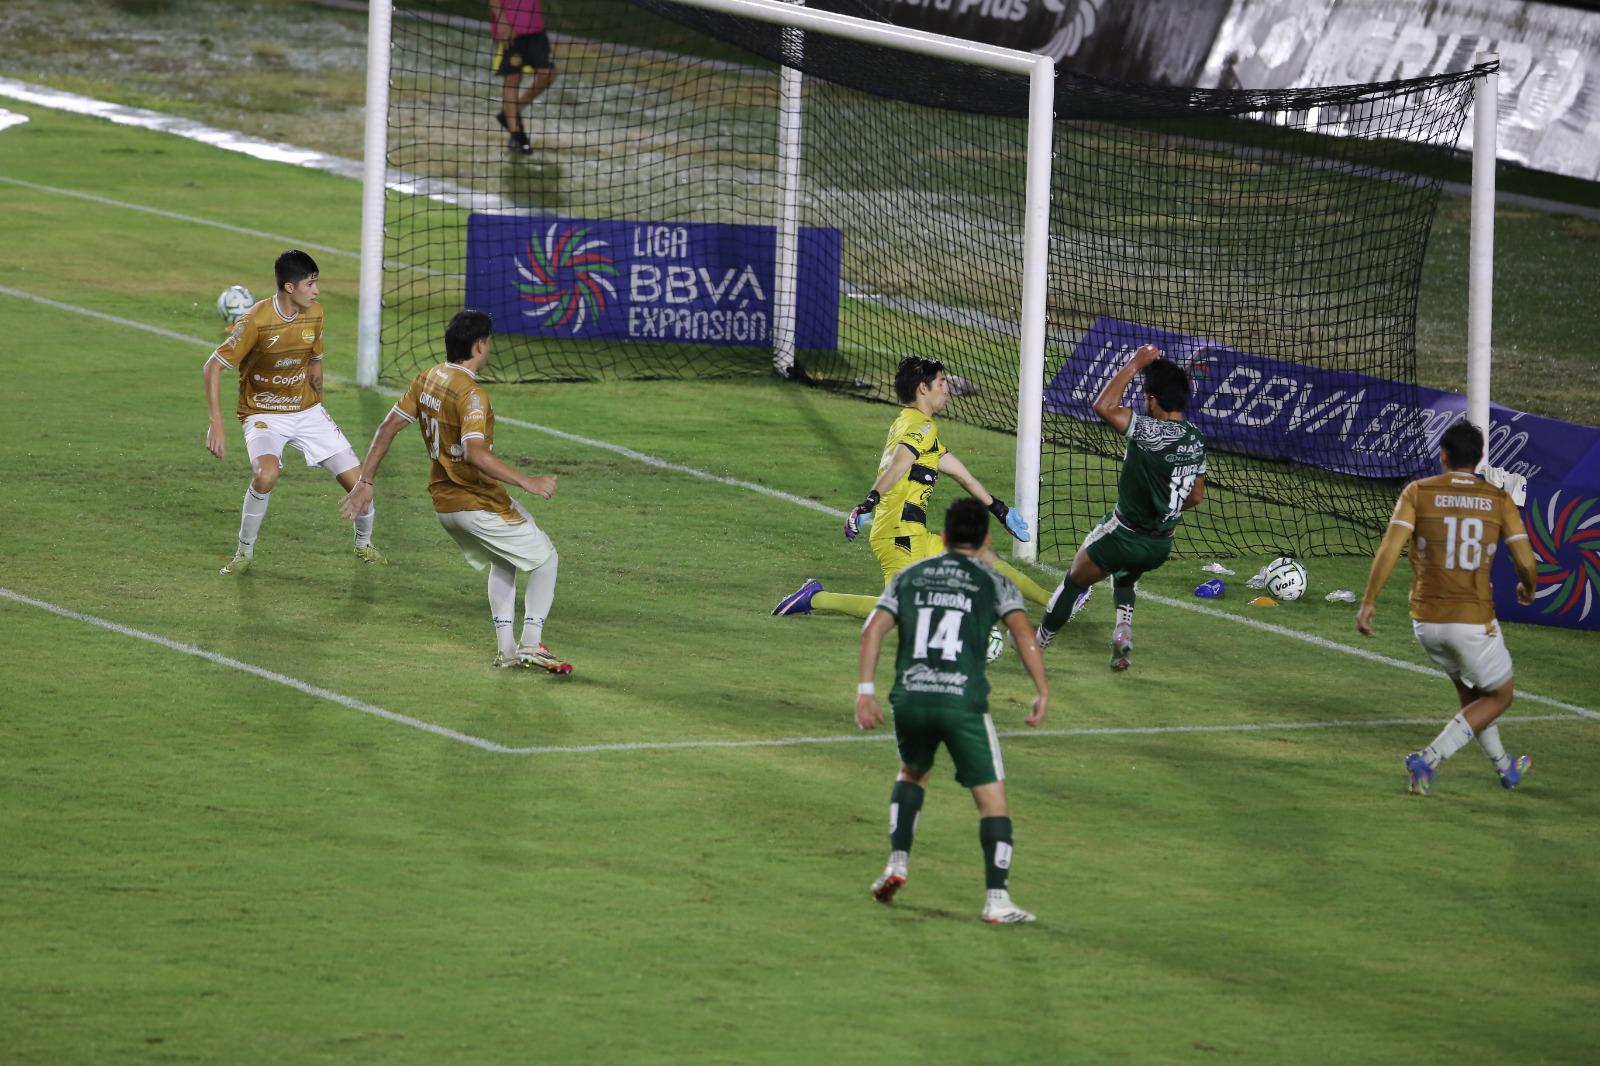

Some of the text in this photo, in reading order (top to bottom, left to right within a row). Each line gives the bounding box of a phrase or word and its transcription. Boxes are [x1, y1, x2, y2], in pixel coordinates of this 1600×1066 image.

[633, 225, 688, 259] LIGA
[629, 263, 767, 305] BBVA
[628, 301, 767, 342] EXPANSIÓN
[1200, 365, 1367, 442] BBVA
[1435, 494, 1493, 511] CERVANTES
[1443, 516, 1484, 571] 18
[1275, 578, 1296, 592] Voit
[912, 608, 965, 661] 14
